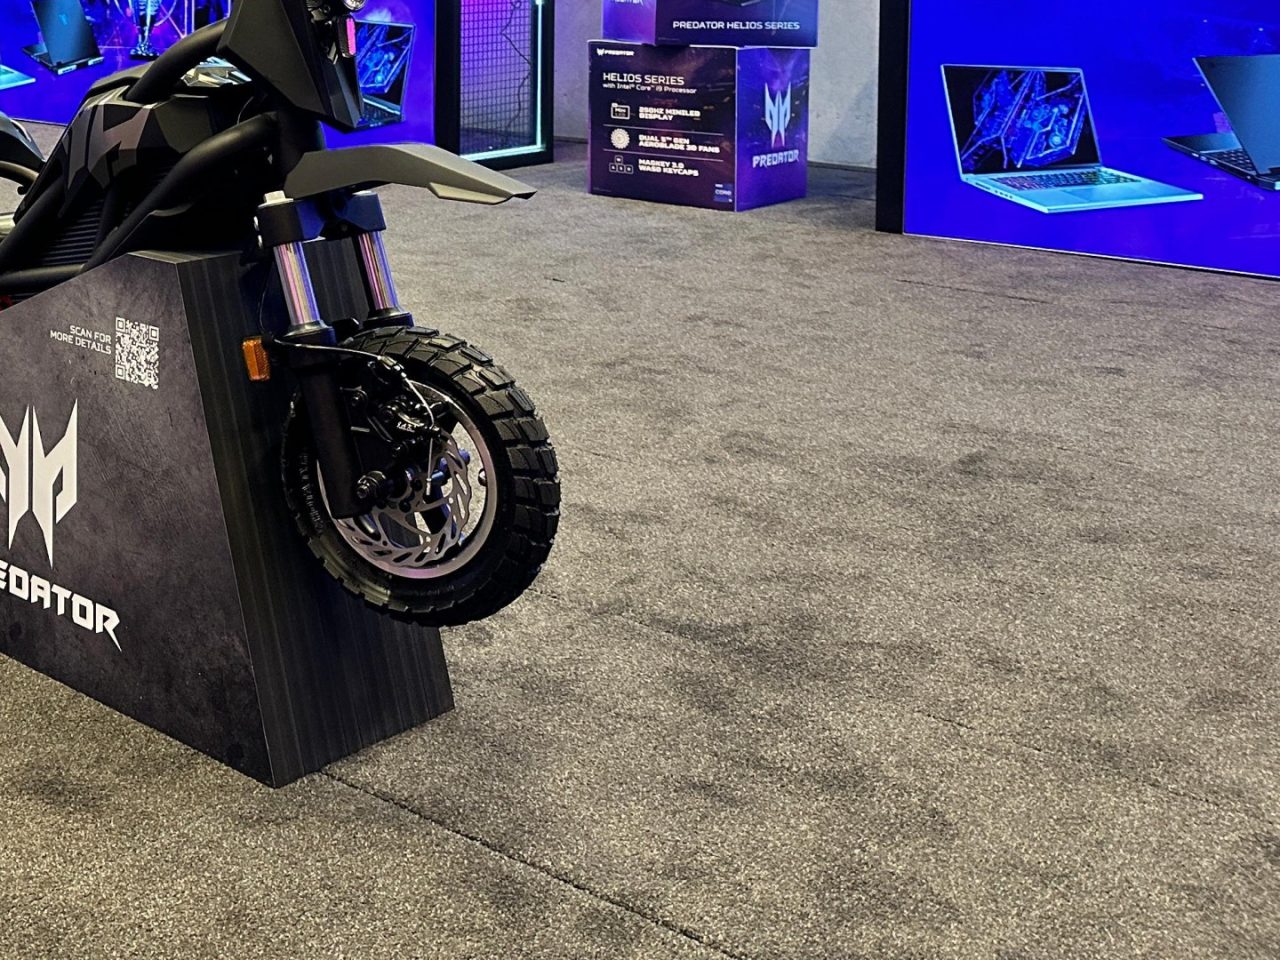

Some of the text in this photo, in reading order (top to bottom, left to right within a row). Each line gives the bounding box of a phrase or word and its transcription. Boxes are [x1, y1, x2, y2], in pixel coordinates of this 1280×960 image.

[672, 20, 800, 31] PREDATOR HELIOS SERIES
[602, 72, 685, 86] HELIOS SERIES
[664, 86, 697, 94] Processor
[639, 112, 674, 121] DISPLAY
[638, 134, 660, 142] DUAL
[638, 140, 685, 150] AEROBLADE
[698, 145, 721, 154] FANS
[752, 148, 800, 168] PREDATOR
[662, 166, 700, 177] KEYCAPS
[70, 325, 112, 344] SCAN FOR
[50, 329, 111, 355] MORE DETAILS
